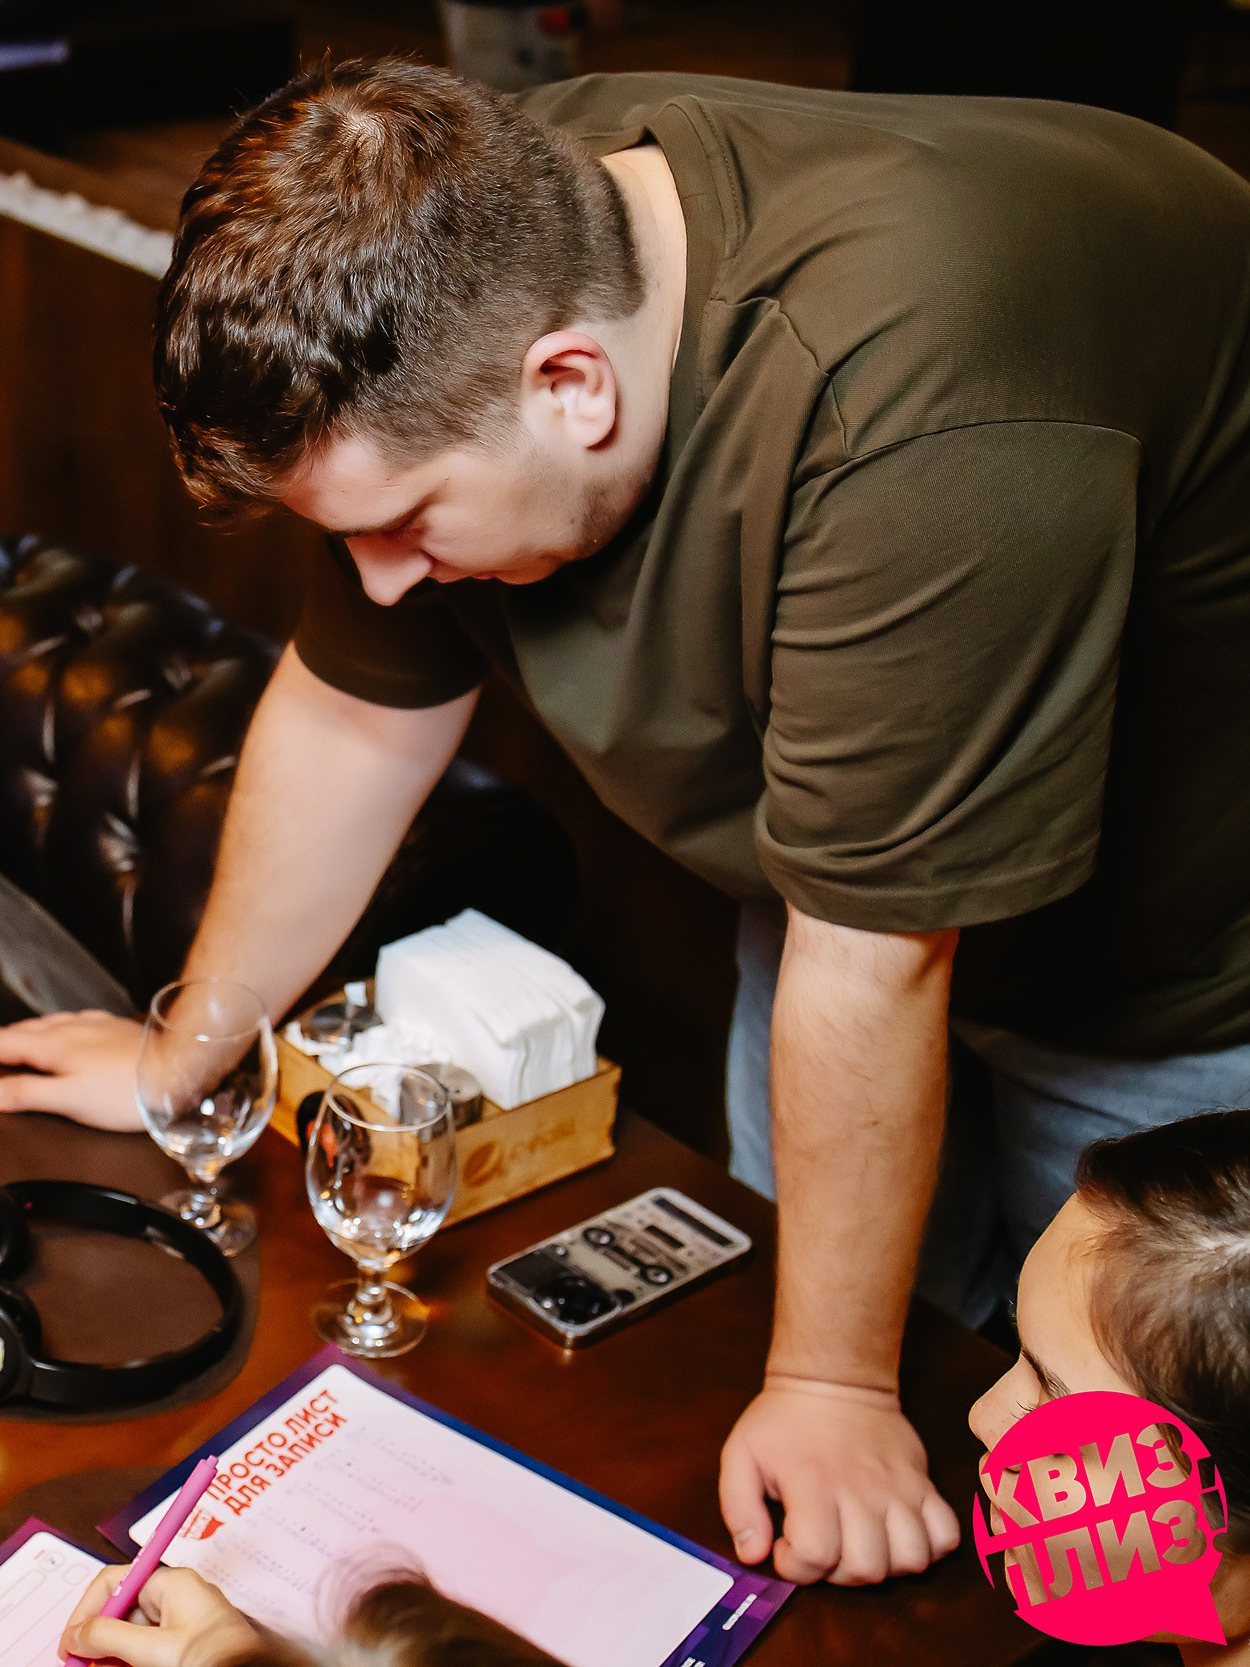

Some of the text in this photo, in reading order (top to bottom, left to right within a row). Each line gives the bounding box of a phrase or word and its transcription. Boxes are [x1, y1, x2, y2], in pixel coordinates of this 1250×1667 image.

[206, 1432, 288, 1500] ПРОСТО
[284, 1389, 338, 1436] ЛИСТ
[223, 1474, 272, 1516] ДЛЯ
[265, 1412, 348, 1478] ЗАПИСИ
